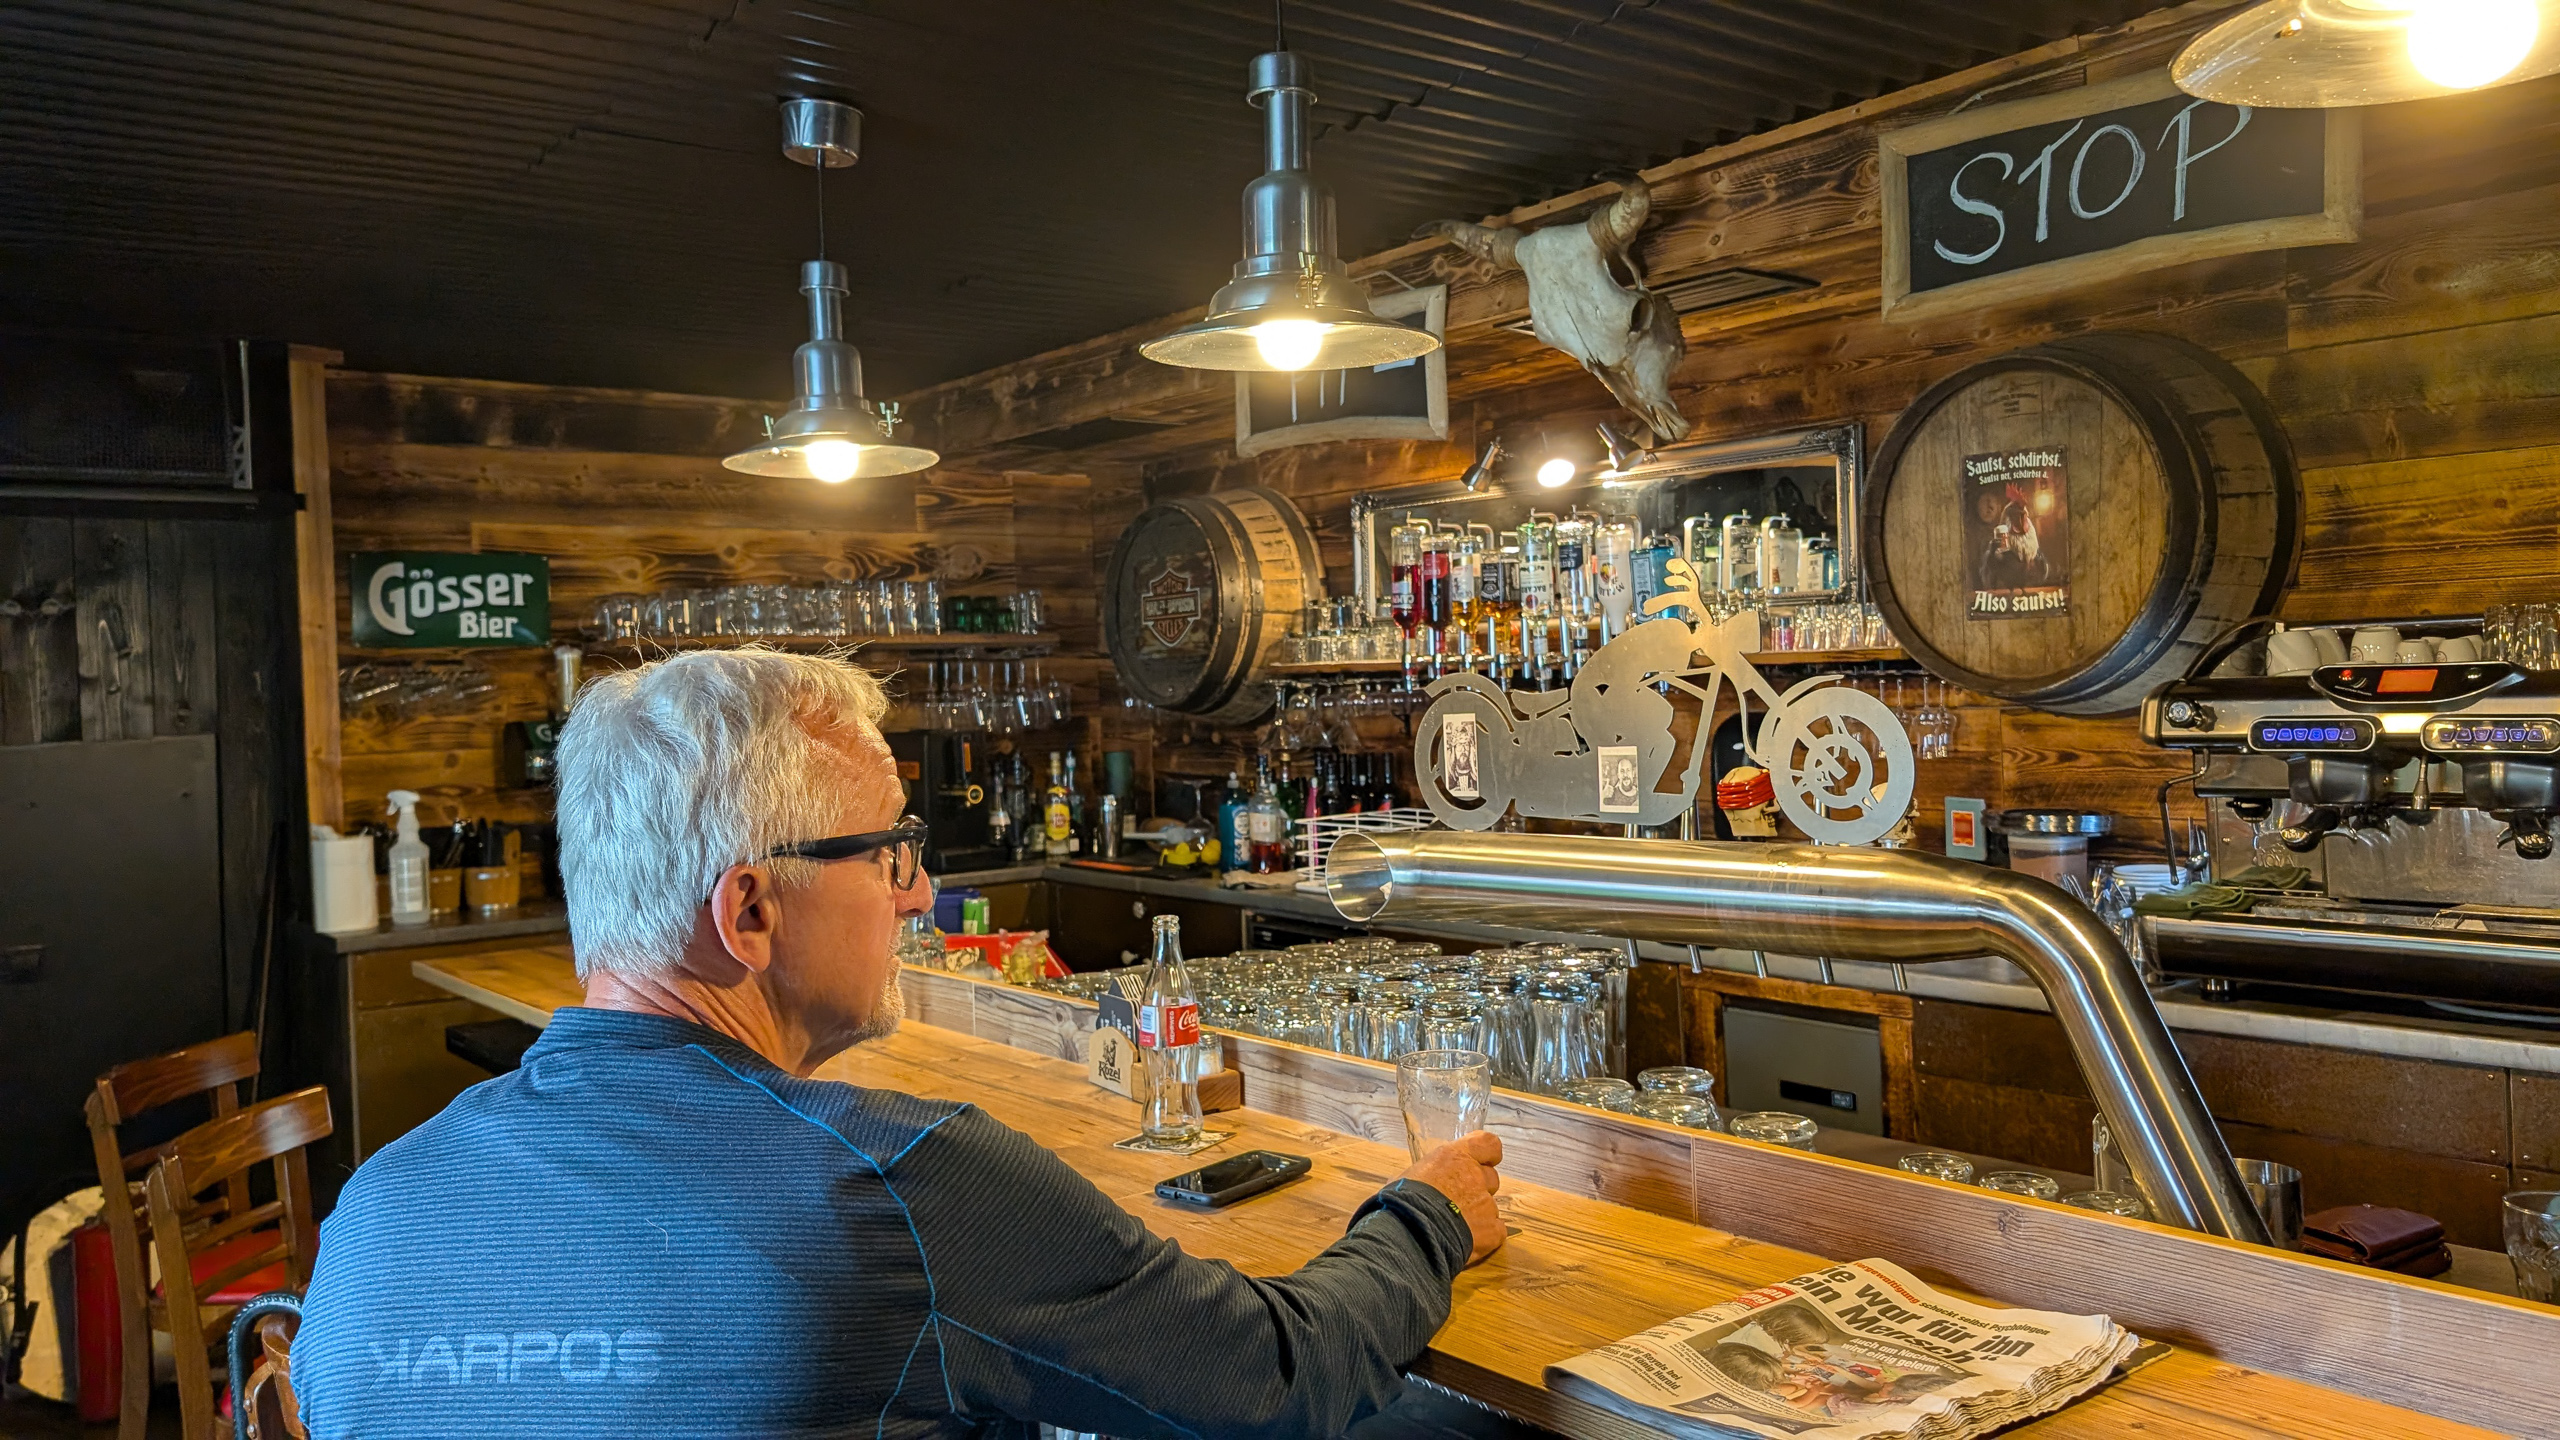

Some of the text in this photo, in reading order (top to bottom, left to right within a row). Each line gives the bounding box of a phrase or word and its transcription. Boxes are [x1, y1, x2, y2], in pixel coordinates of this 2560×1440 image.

[1934, 99, 2253, 265] STOP
[1966, 456, 2006, 477] Saufst,
[368, 561, 534, 636] Gösser
[1971, 588, 2065, 612] Also saufst!
[458, 610, 519, 639] Bier
[1098, 1060, 1121, 1082] Kozel
[1817, 1265, 2035, 1357] ie war für ihn
[1988, 1323, 2051, 1336] Psychologen
[1841, 1343, 1940, 1373] wird eifrig gelernt
[1849, 1338, 1880, 1349] Auch
[1878, 1345, 1899, 1355] am
[1633, 1356, 1655, 1372] König
[1653, 1370, 1681, 1390] Harald
[1642, 1352, 1668, 1371] Royals
[1666, 1369, 1683, 1380] bei
